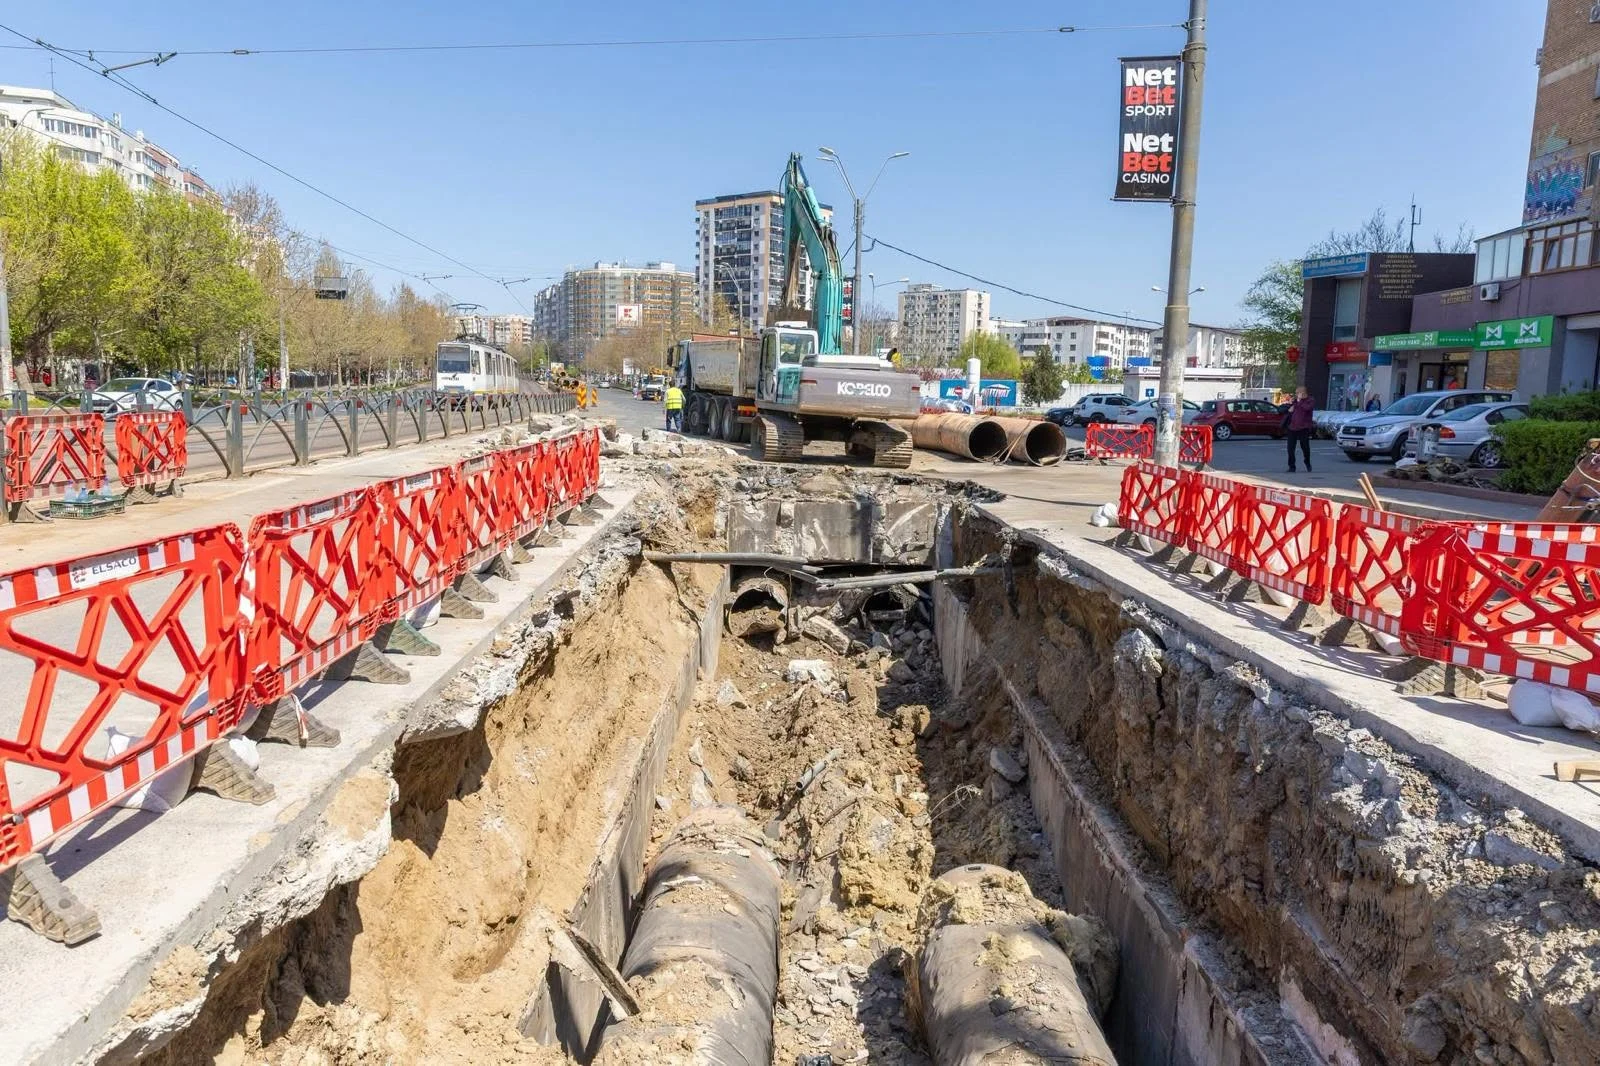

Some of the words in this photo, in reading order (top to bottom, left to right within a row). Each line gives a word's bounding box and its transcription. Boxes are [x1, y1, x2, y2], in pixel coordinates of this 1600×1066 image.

[1125, 67, 1176, 86] Net
[1125, 86, 1176, 105] Bet
[1125, 105, 1175, 116] SPORT
[1123, 133, 1174, 153] Net
[1122, 153, 1173, 172] Bet
[1122, 173, 1170, 184] CASINO
[837, 382, 891, 397] KOBELCO
[92, 556, 137, 575] ELSACO
